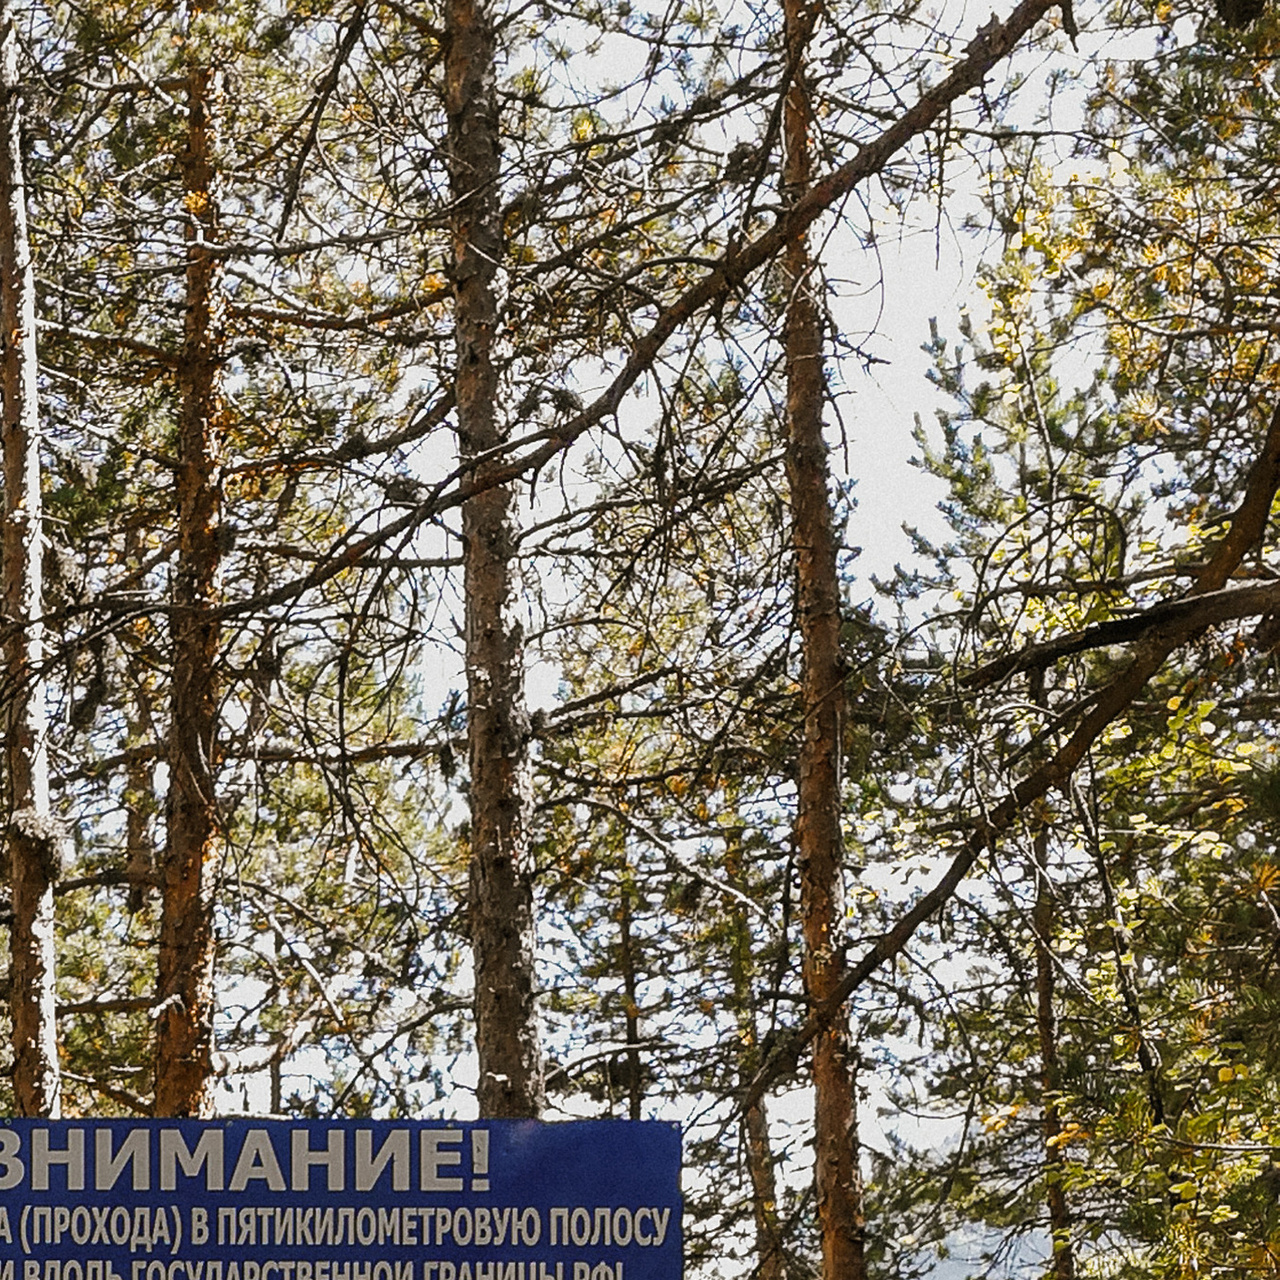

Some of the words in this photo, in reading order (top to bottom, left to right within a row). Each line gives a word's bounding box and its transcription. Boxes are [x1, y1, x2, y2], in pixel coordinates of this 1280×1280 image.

[21, 1205, 181, 1254] (ПРОХОДА)
[192, 1208, 208, 1244] В
[218, 1208, 540, 1245] ПЯТИКИЛОМЕТРОВУЮ
[550, 1208, 670, 1245] ПОЛОСУ
